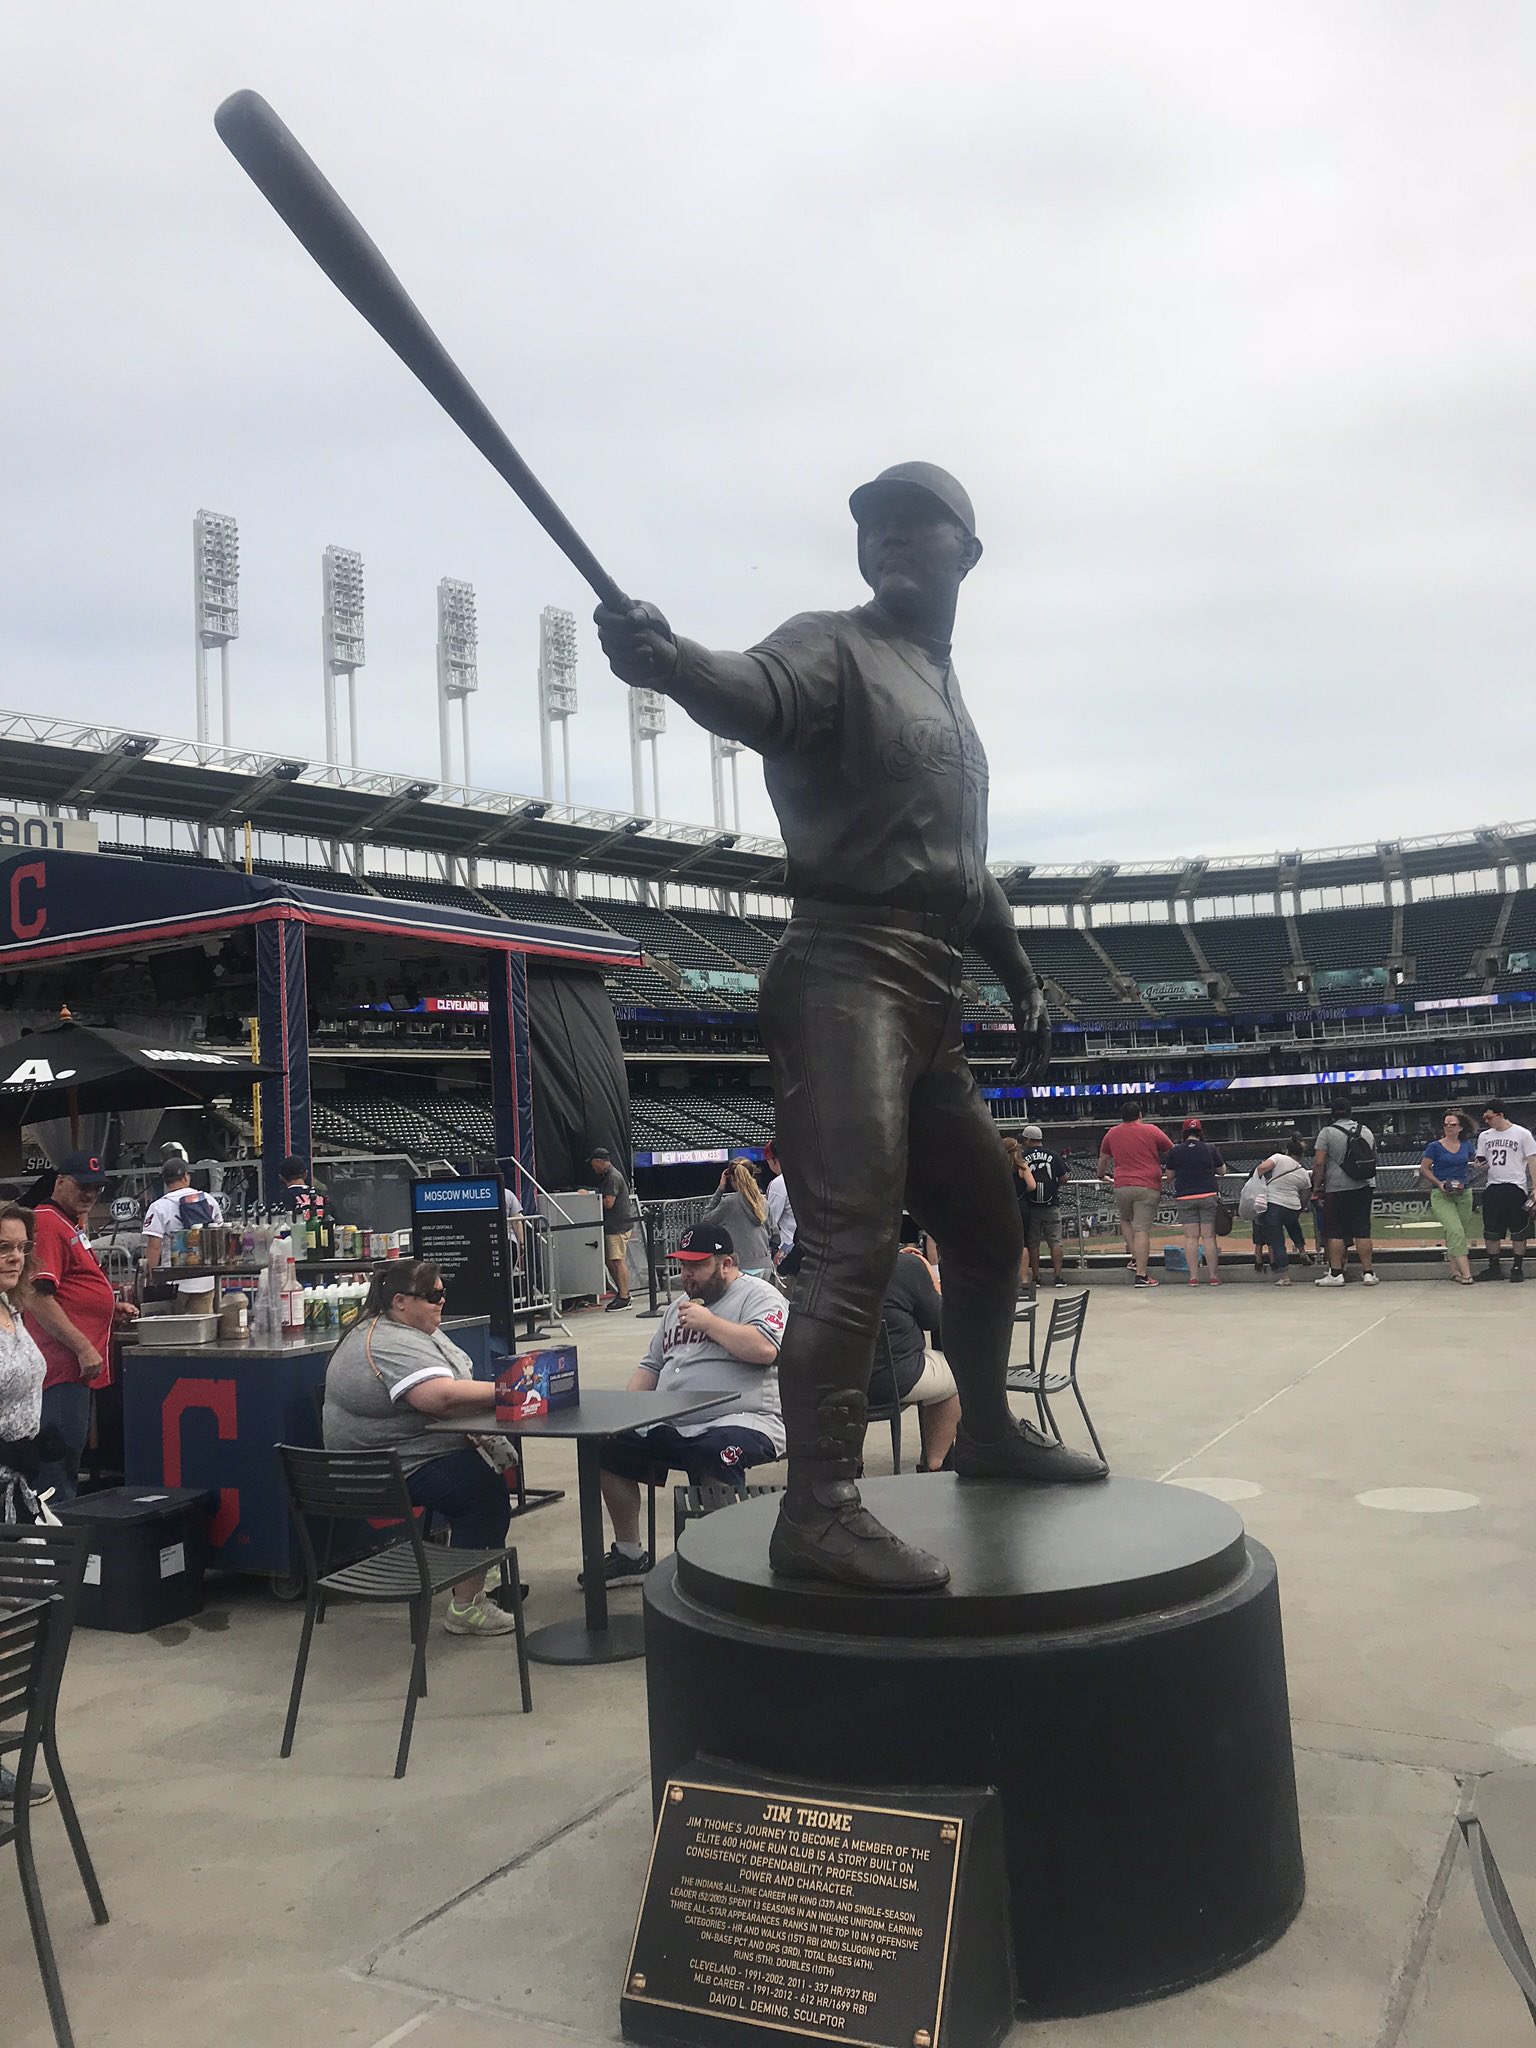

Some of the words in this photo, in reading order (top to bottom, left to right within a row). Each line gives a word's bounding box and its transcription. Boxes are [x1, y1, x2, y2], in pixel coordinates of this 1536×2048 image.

[10, 861, 47, 939] C
[437, 1000, 478, 1011] CLEVELAND
[1142, 985, 1187, 1000] Indians
[88, 1157, 100, 1171] C
[1492, 1150, 1507, 1166] 23
[116, 1202, 132, 1214] FOX
[424, 1190, 461, 1202] MOSCOW
[462, 1188, 491, 1200] MULES
[1371, 1199, 1430, 1216] Energy
[663, 1325, 716, 1354] CLEVEL
[162, 1377, 240, 1548] C
[763, 1804, 793, 1824] JIM
[797, 1808, 853, 1832] THOME
[686, 1816, 702, 1828] JIM
[704, 1818, 742, 1834] THOME'S
[744, 1823, 786, 1840] JOURNEY
[788, 1830, 800, 1842] TO
[801, 1832, 840, 1848] BECOME
[842, 1838, 849, 1849] A
[851, 1839, 893, 1856] MEMBER
[895, 1846, 909, 1857] OF
[911, 1847, 931, 1861] THE
[696, 1832, 721, 1846] ELITE
[722, 1836, 738, 1848] 600
[739, 1838, 768, 1853] HOME
[767, 1842, 788, 1856] RUN
[790, 1846, 815, 1860] CLUB
[816, 1849, 826, 1861] IS
[828, 1851, 835, 1863] A
[837, 1853, 868, 1868] STORY
[869, 1857, 898, 1872] BUILT
[900, 1862, 914, 1874] ON
[680, 1876, 695, 1887] THE
[695, 1877, 723, 1891] INDIANS
[724, 1883, 757, 1897] ALL-TIME
[758, 1889, 787, 1902] CAREER
[787, 1893, 798, 1904] HR
[799, 1895, 818, 1907] KING
[836, 1902, 853, 1913] AND
[853, 1904, 916, 1923] SINGLE-SEASON
[739, 1868, 772, 1884] POWER
[774, 1874, 795, 1888] AND
[796, 1876, 855, 1897] CHARACTER.
[670, 1886, 698, 1899] LEADER
[728, 1896, 752, 1908] SPENT
[753, 1900, 761, 1910] 13
[761, 1902, 796, 1916] SEASONS
[796, 1907, 805, 1918] IN
[806, 1909, 817, 1919] AN
[818, 1911, 849, 1926] INDIANS
[888, 1923, 923, 1938] EARNING
[670, 1899, 693, 1912] THREE
[693, 1902, 727, 1918] ALL-STAR
[782, 1918, 808, 1932] RANKS
[809, 1923, 818, 1933] IN
[819, 1924, 834, 1936] THE
[835, 1927, 850, 1938] TOP
[851, 1930, 860, 1940] 10
[860, 1932, 869, 1942] IN
[870, 1934, 876, 1943] 9
[876, 1935, 919, 1951] OFFENSIVE
[685, 1915, 726, 1931] CATEGORIES
[732, 1923, 743, 1934] HR
[743, 1925, 760, 1937] AND
[761, 1928, 787, 1941] WALKS
[787, 1932, 805, 1945] (1ST)
[806, 1936, 820, 1947] RBI
[820, 1938, 841, 1951] (2ND)
[841, 1942, 880, 1958] SLUGGING
[700, 1930, 733, 1945] ON-BASE
[733, 1936, 748, 1947] PCT
[748, 1939, 765, 1951] AND
[765, 1942, 780, 1954] OPS
[804, 1949, 826, 1962] TOTAL
[827, 1953, 853, 1967] BASES
[690, 1958, 737, 1977] CLEVELAND
[787, 1976, 806, 1990] 2011
[814, 1981, 828, 1994] 337
[830, 1985, 861, 2001] HR/937
[862, 1990, 877, 2003] RBI
[733, 1949, 754, 1963] RUNS
[776, 1957, 811, 1973] DOUBLES
[811, 1964, 835, 1978] (10TH)
[693, 1972, 711, 1985] MLB
[713, 1976, 745, 1991] CAREER
[753, 1984, 793, 2001] 1991-2012
[800, 1993, 814, 2005] 612
[816, 1996, 851, 2011] HR/1699
[852, 2003, 868, 2015] RBI
[709, 1991, 737, 2008] DAVID
[739, 1997, 748, 2010] L.
[793, 2008, 846, 2029] SCULPTOR
